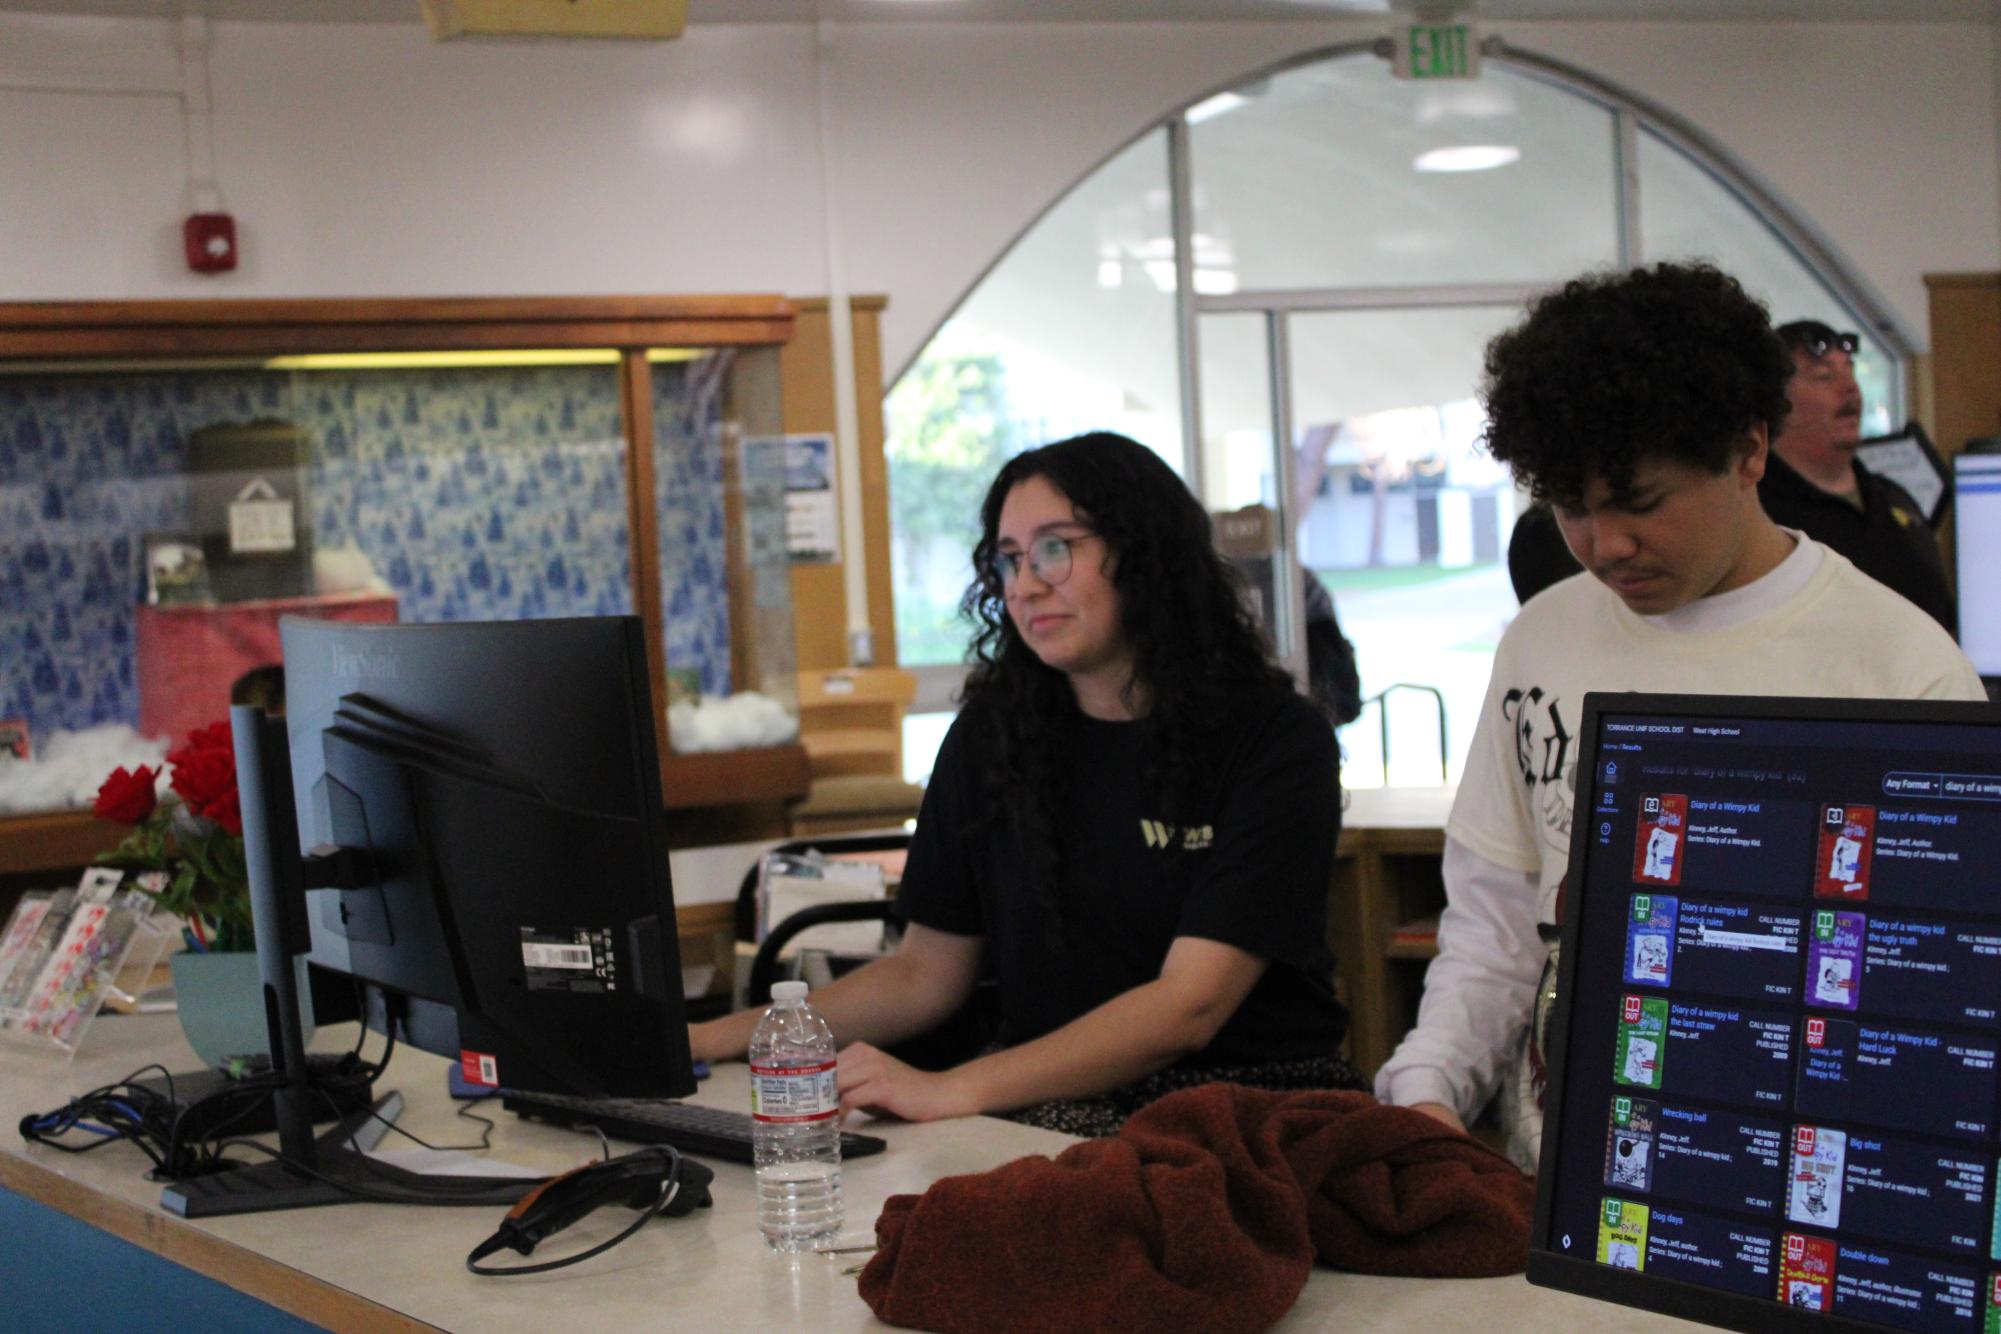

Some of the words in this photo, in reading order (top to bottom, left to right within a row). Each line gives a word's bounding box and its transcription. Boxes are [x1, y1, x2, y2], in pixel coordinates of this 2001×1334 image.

[1410, 25, 1469, 78] EXIT
[1886, 780, 1901, 789] Any
[1903, 781, 1930, 789] Format
[1945, 783, 1964, 791] diary
[1967, 783, 1975, 791] of
[1691, 801, 1707, 811] Diary
[1709, 802, 1717, 810] of
[1724, 803, 1746, 813] Wimpy
[1748, 804, 1760, 812] Kid
[1880, 812, 1898, 822] Diary
[1900, 813, 1908, 821] of
[1917, 814, 1942, 824] Wimpy
[1944, 815, 1957, 823] Kid
[1681, 903, 1698, 913] Diary
[1700, 904, 1707, 912] of
[1715, 906, 1736, 916] wimpy
[1738, 908, 1748, 916] kid
[1707, 917, 1723, 926] rules
[1775, 917, 1800, 925] NUMBER
[1870, 920, 1888, 931] Diary
[1891, 922, 1899, 930] of
[1907, 923, 1930, 934] wimpy
[1933, 925, 1945, 934] kid
[1869, 933, 1880, 942] the
[1882, 935, 1897, 945] ugly
[1899, 936, 1917, 945] truth
[1957, 934, 1973, 942] CALL
[1672, 1006, 1688, 1016] Diary
[1690, 1008, 1697, 1016] of
[1705, 1009, 1726, 1021] wimpy
[1728, 1012, 1739, 1021] kid
[1671, 1018, 1681, 1026] the
[1683, 1020, 1695, 1028] last
[1697, 1021, 1715, 1030] straw
[1749, 1021, 1763, 1029] CALL
[1765, 1022, 1790, 1031] NUMBER
[1807, 1035, 1821, 1044] OUT
[1860, 1029, 1879, 1041] Diary
[1881, 1031, 1889, 1040] of
[1897, 1033, 1922, 1046] Wimpy
[1925, 1037, 1937, 1046] Kid
[1859, 1042, 1876, 1052] Hard
[1879, 1045, 1896, 1054] Luck
[1947, 1047, 1964, 1056] CALL
[1966, 1049, 1994, 1058] NUMBER
[1810, 1059, 1826, 1069] Diary
[1828, 1061, 1835, 1069] of
[1806, 1069, 1828, 1079] Wimpy
[1830, 1071, 1840, 1079] Kid
[1662, 1108, 1692, 1121] Wrecking
[1695, 1112, 1707, 1121] ball
[1739, 1127, 1753, 1135] CALL
[1755, 1129, 1781, 1139] NUMBER
[1798, 1143, 1812, 1152] OUT
[1850, 1138, 1861, 1149] Big
[1864, 1140, 1880, 1150] shot
[1937, 1159, 1953, 1168] CALL
[1955, 1161, 1984, 1172] NUMBER
[1653, 1211, 1666, 1223] Dog
[1667, 1213, 1683, 1225] days
[1730, 1233, 1744, 1242] CALL
[1745, 1236, 1771, 1246] NUMBER
[1788, 1252, 1803, 1261] OUT
[1840, 1248, 1866, 1261] Double
[1868, 1253, 1889, 1265] down
[1928, 1273, 1945, 1283] CALL
[1947, 1275, 1974, 1287] NUMBER
